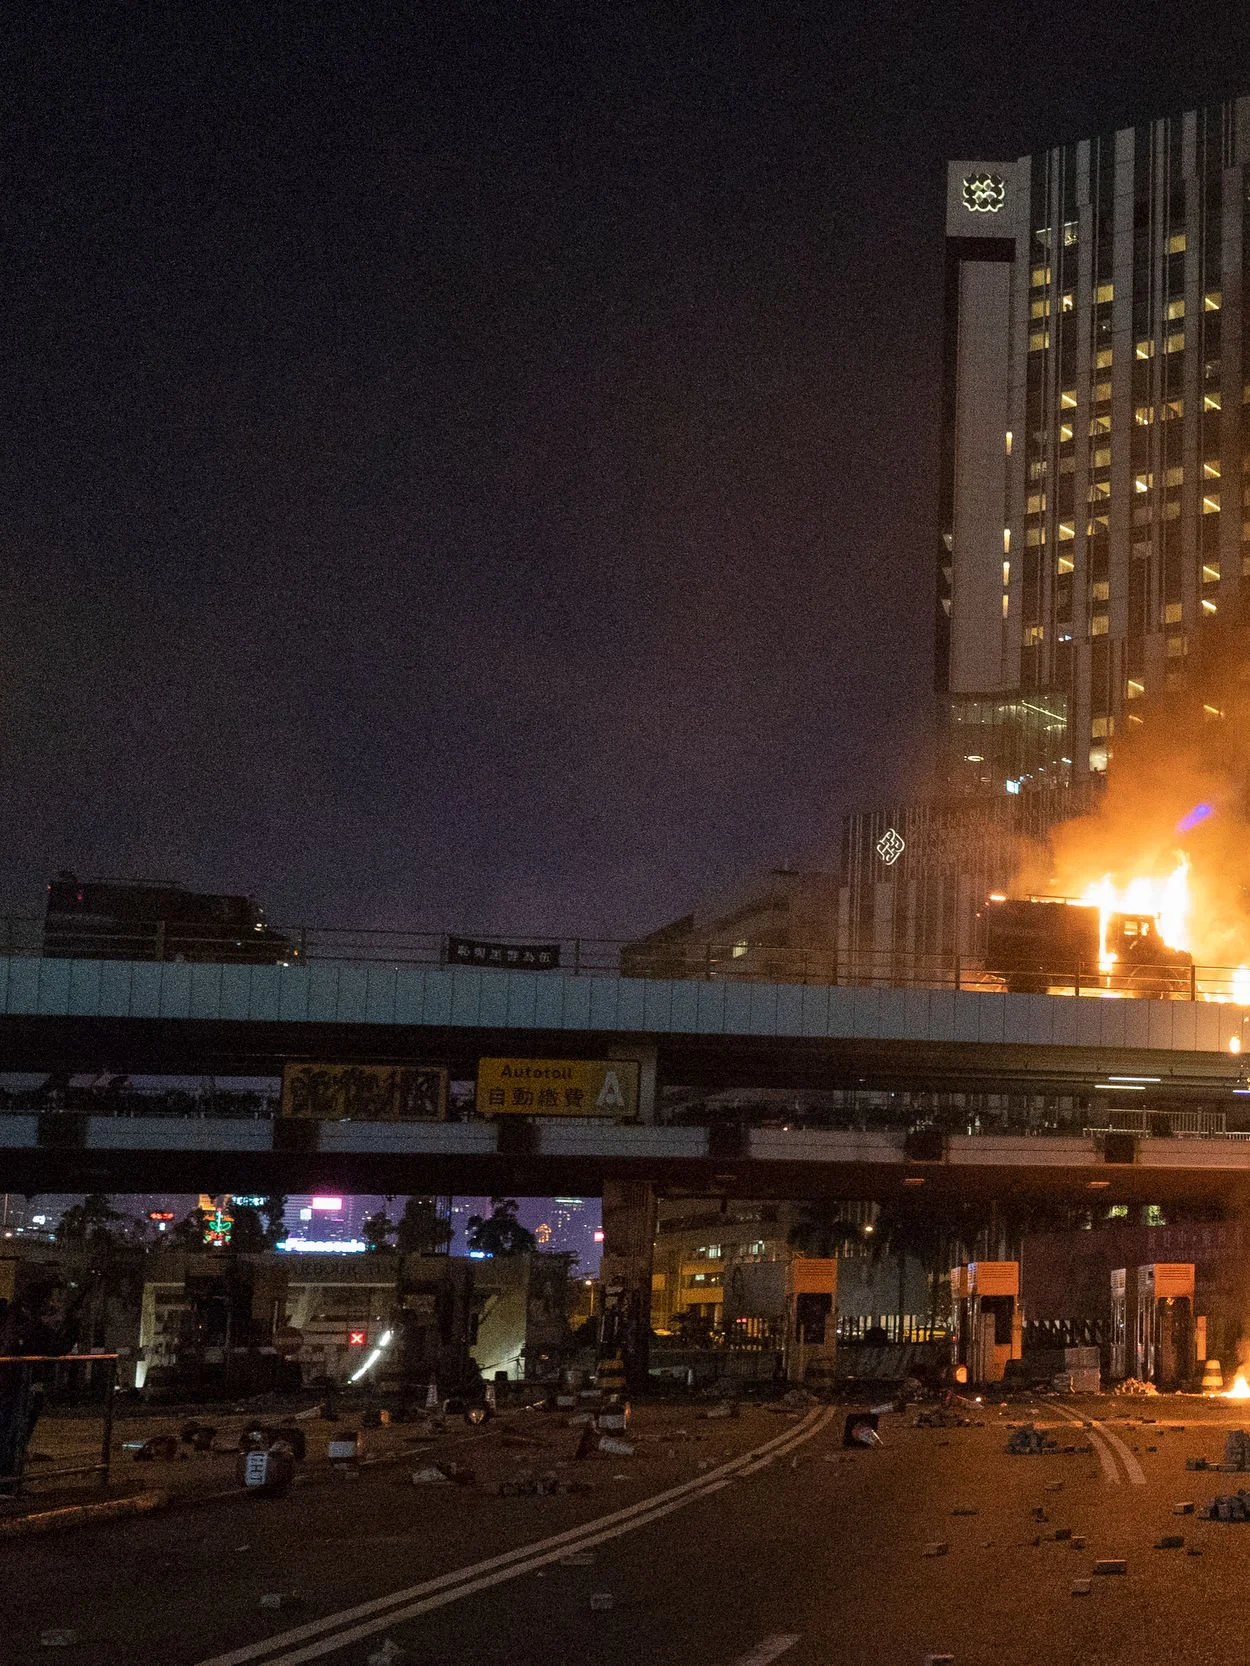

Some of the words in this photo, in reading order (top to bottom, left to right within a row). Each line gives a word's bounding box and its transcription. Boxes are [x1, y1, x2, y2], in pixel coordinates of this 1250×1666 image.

[502, 1064, 572, 1080] Autotoll
[489, 1087, 584, 1107] 自動繳費
